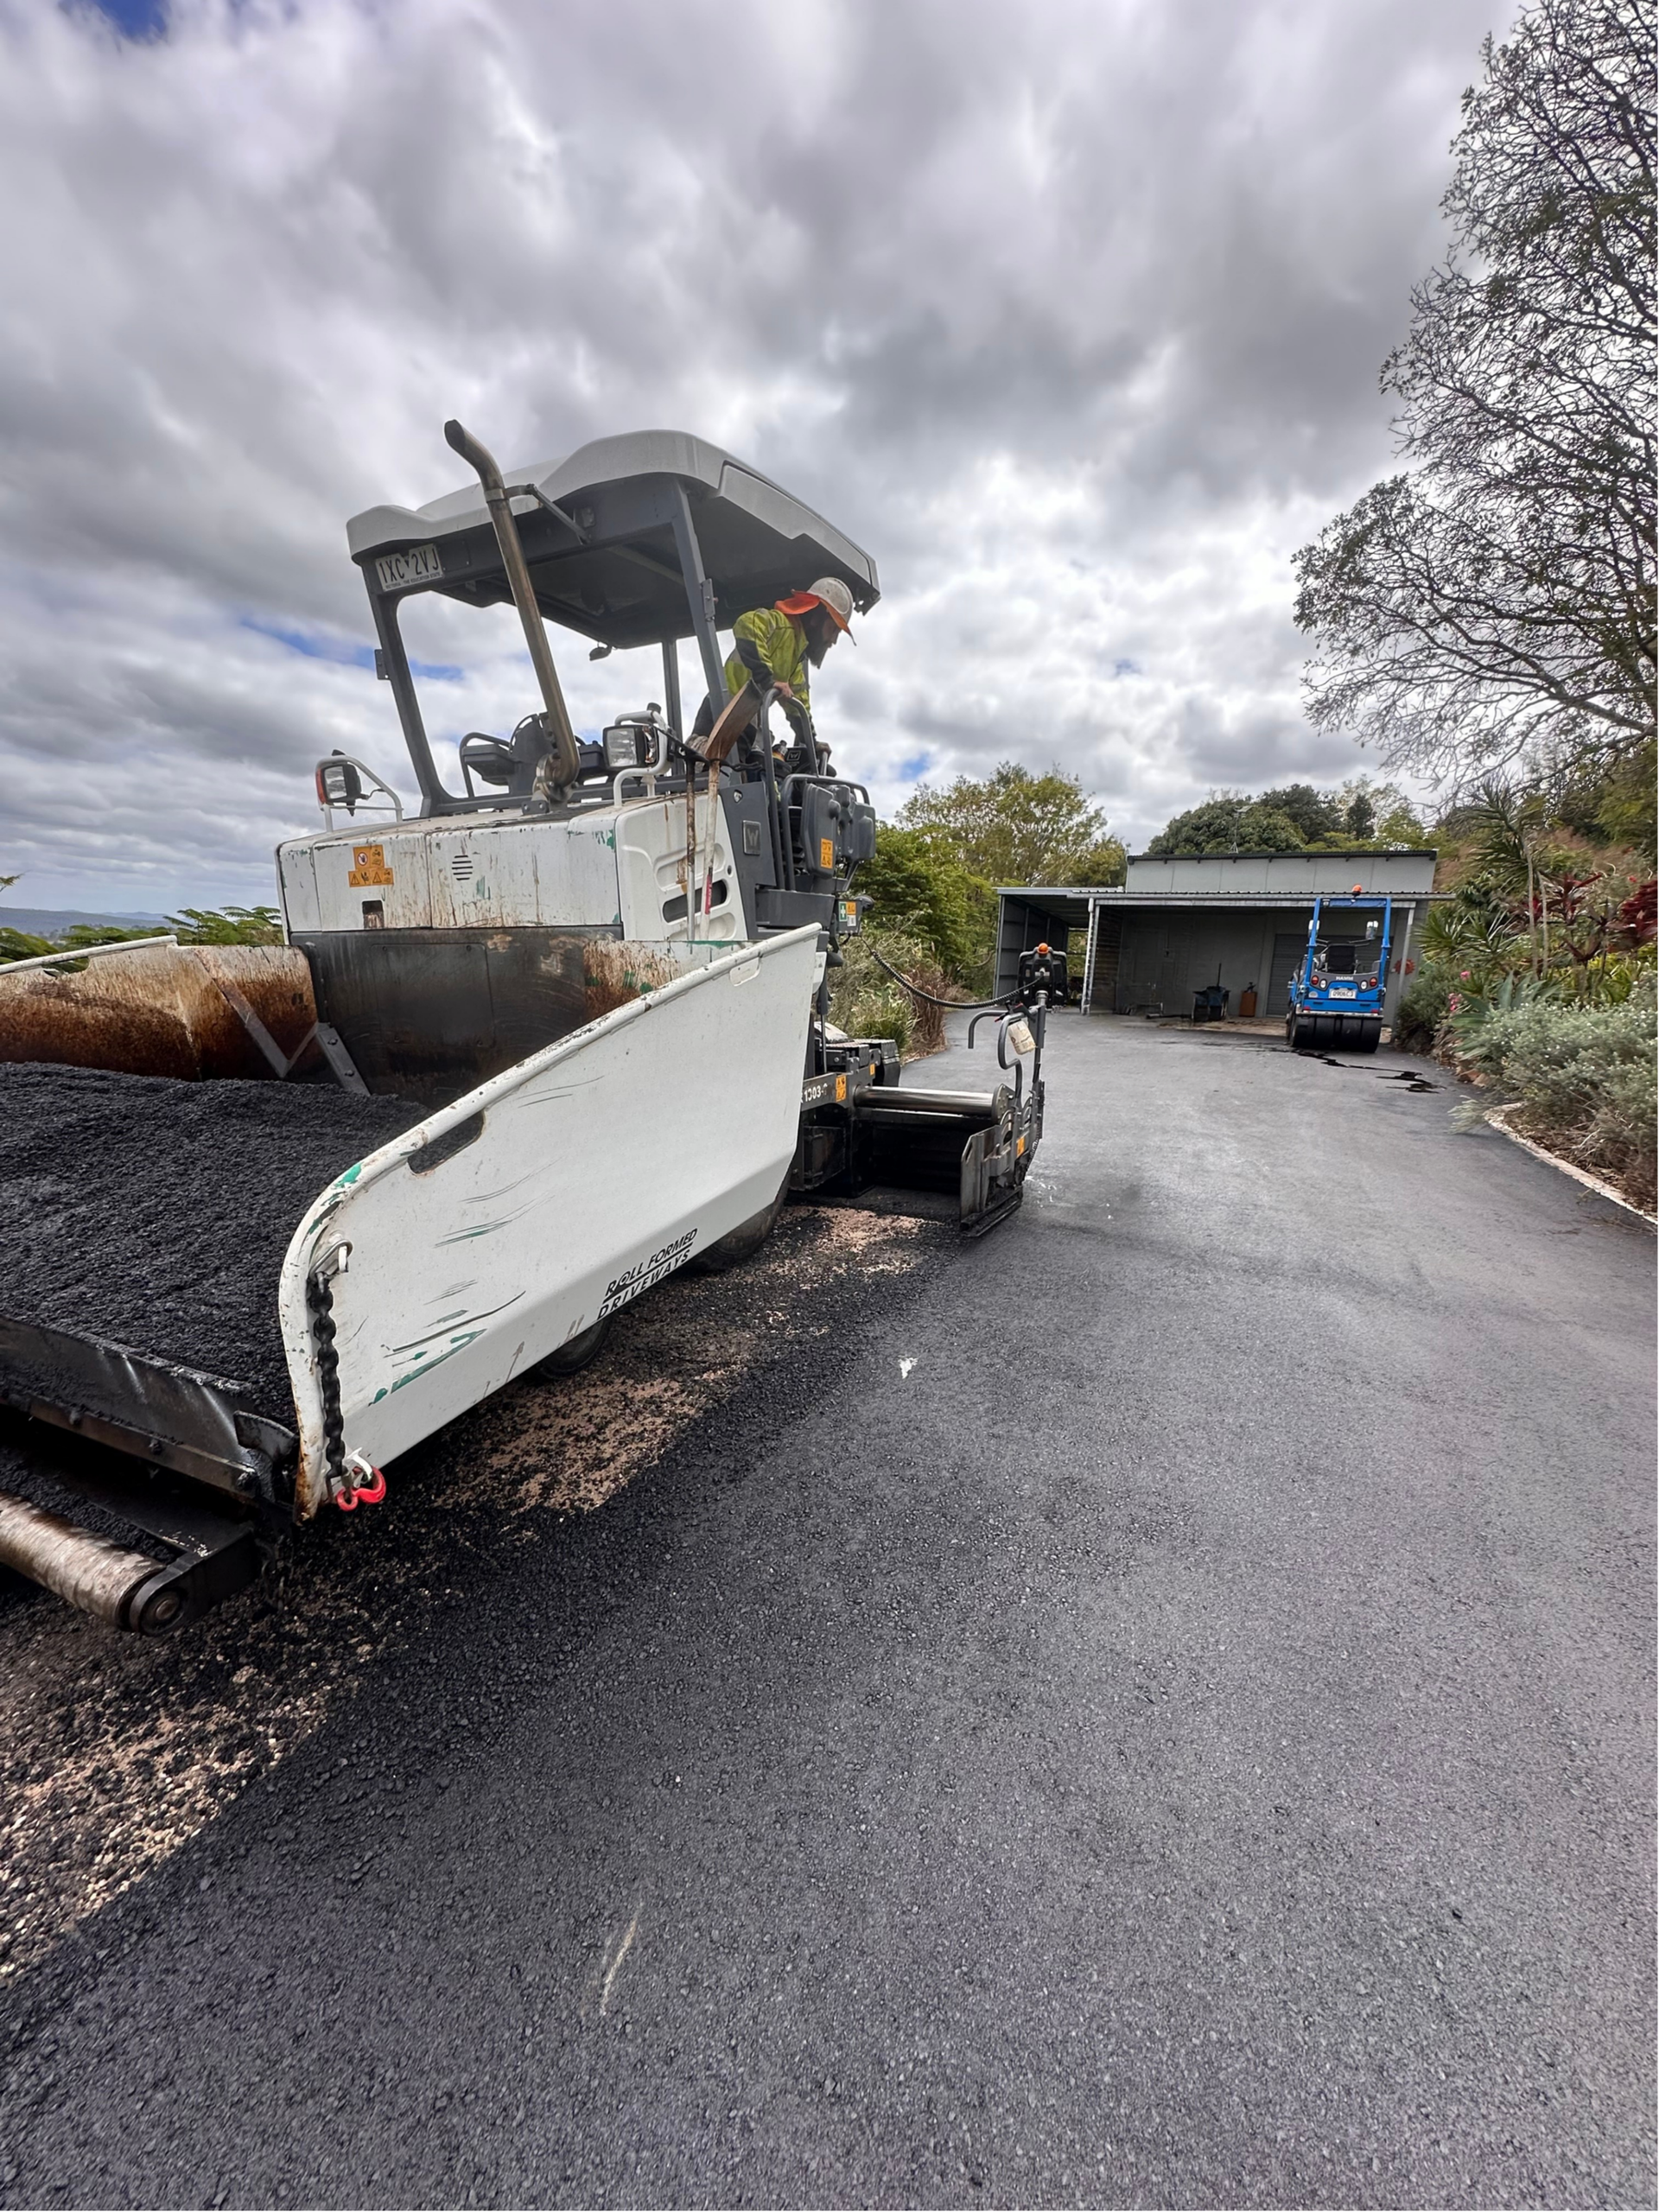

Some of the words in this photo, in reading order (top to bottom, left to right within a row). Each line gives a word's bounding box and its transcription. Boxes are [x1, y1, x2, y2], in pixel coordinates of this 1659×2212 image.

[747, 828, 759, 846] W
[597, 1249, 690, 1320] DRIVEWAYS
[605, 1262, 644, 1297] ROLL
[647, 1228, 697, 1269] FORMED
